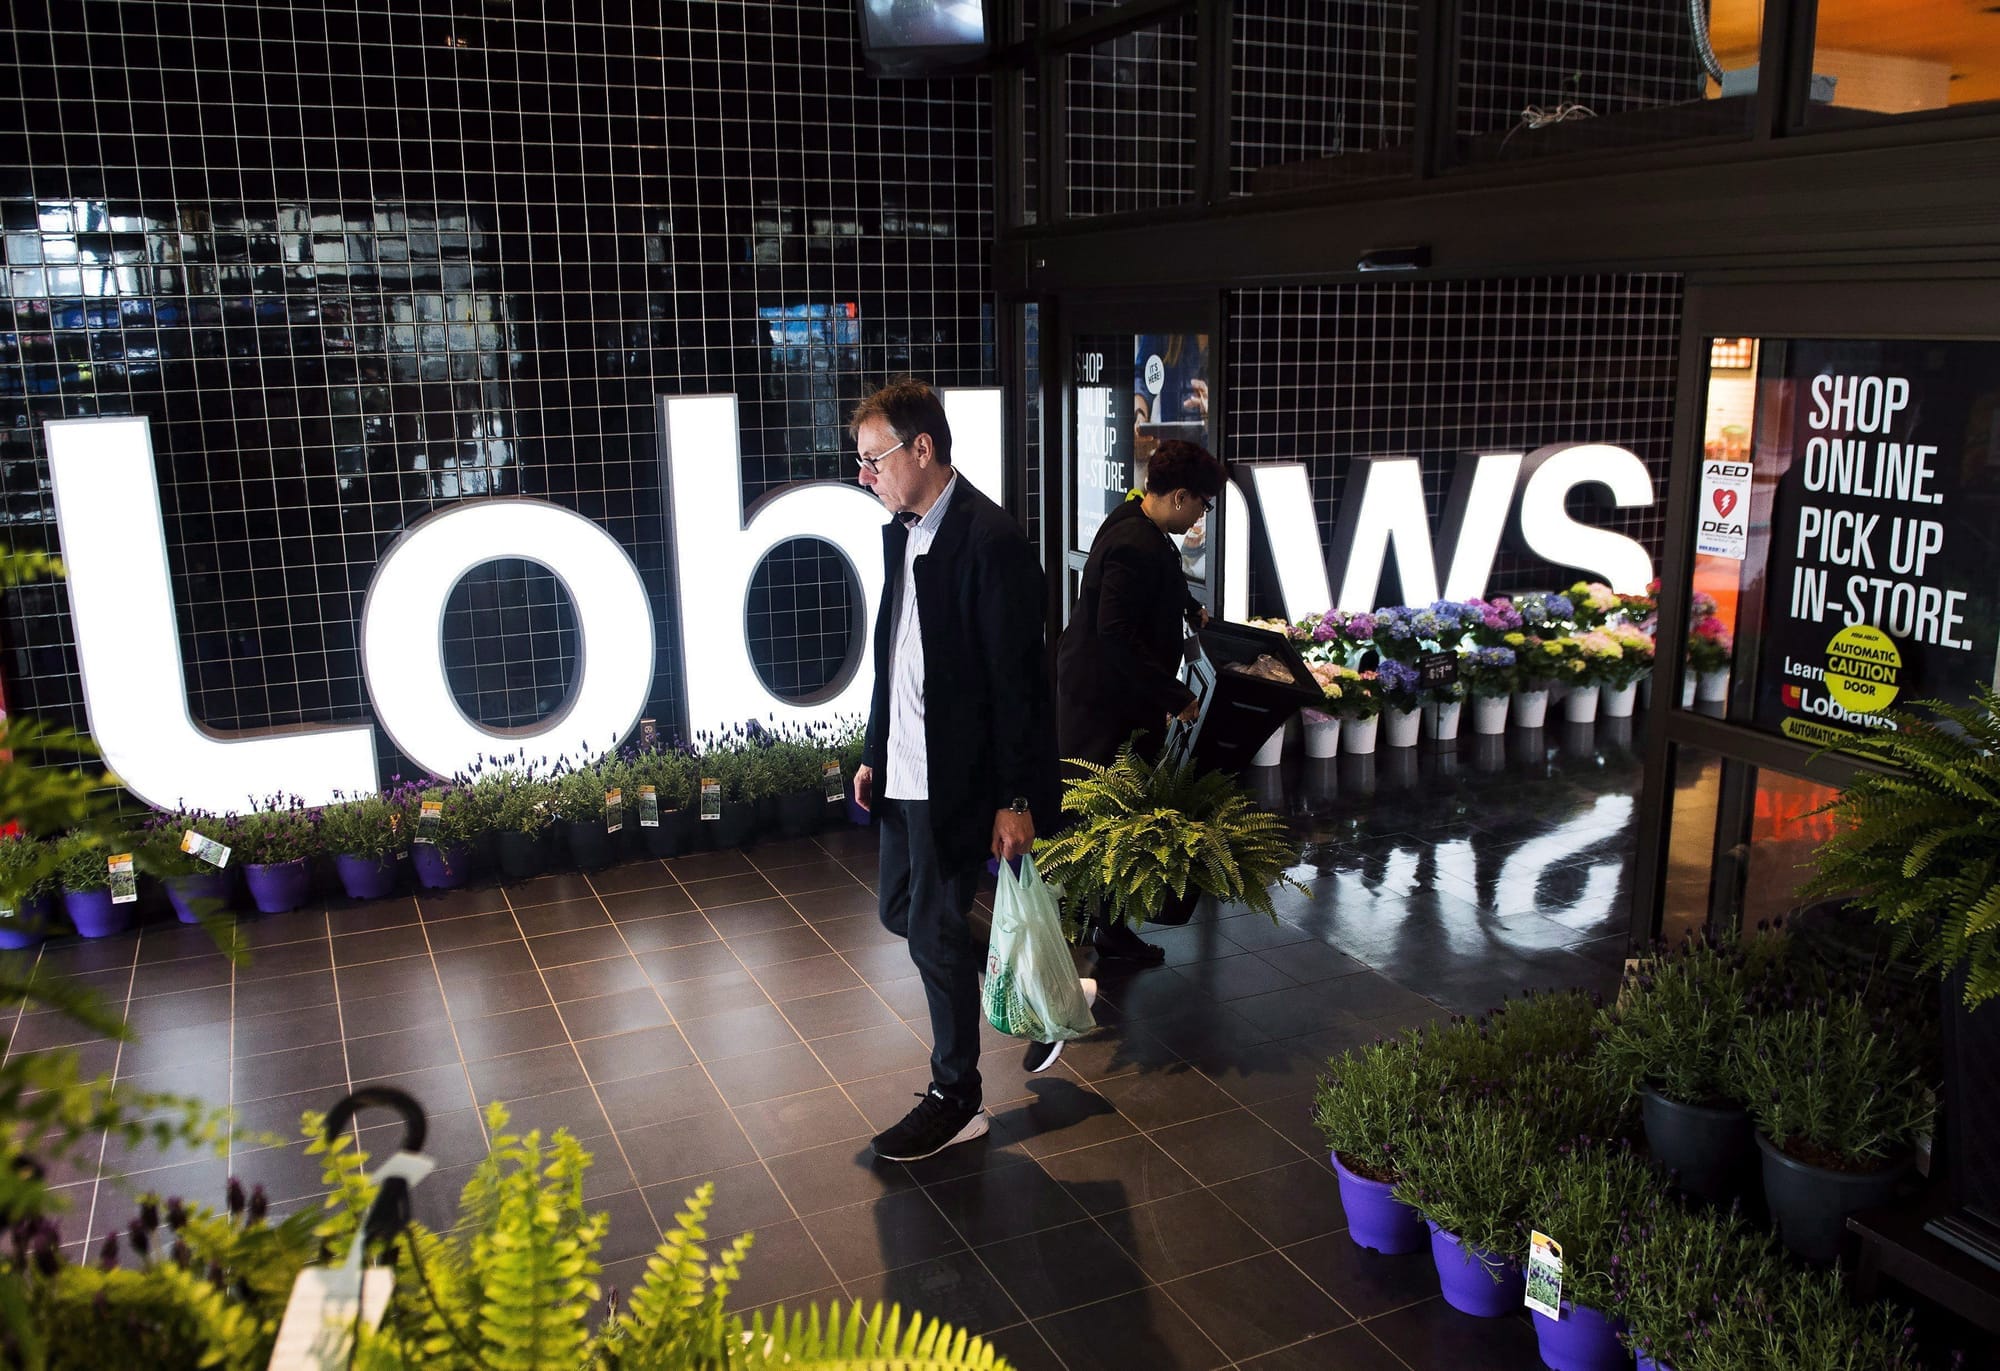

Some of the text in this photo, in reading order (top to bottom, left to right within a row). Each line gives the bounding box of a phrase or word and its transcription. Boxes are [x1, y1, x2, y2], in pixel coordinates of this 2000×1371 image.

[1808, 374, 1910, 434] SHOP
[1102, 425, 1117, 457] UP
[1707, 464, 1749, 478] AED
[1803, 437, 1944, 504] ONLINE.
[1702, 521, 1743, 536] DEA
[1796, 506, 1943, 577] PICK UP
[1790, 567, 1973, 652] IN-STORE.
[1832, 642, 1896, 663] AUTOMATIC
[1828, 657, 1897, 684] CAUTION
[1843, 680, 1876, 696] DOOR
[1789, 721, 1836, 743] AUTOMATIC
